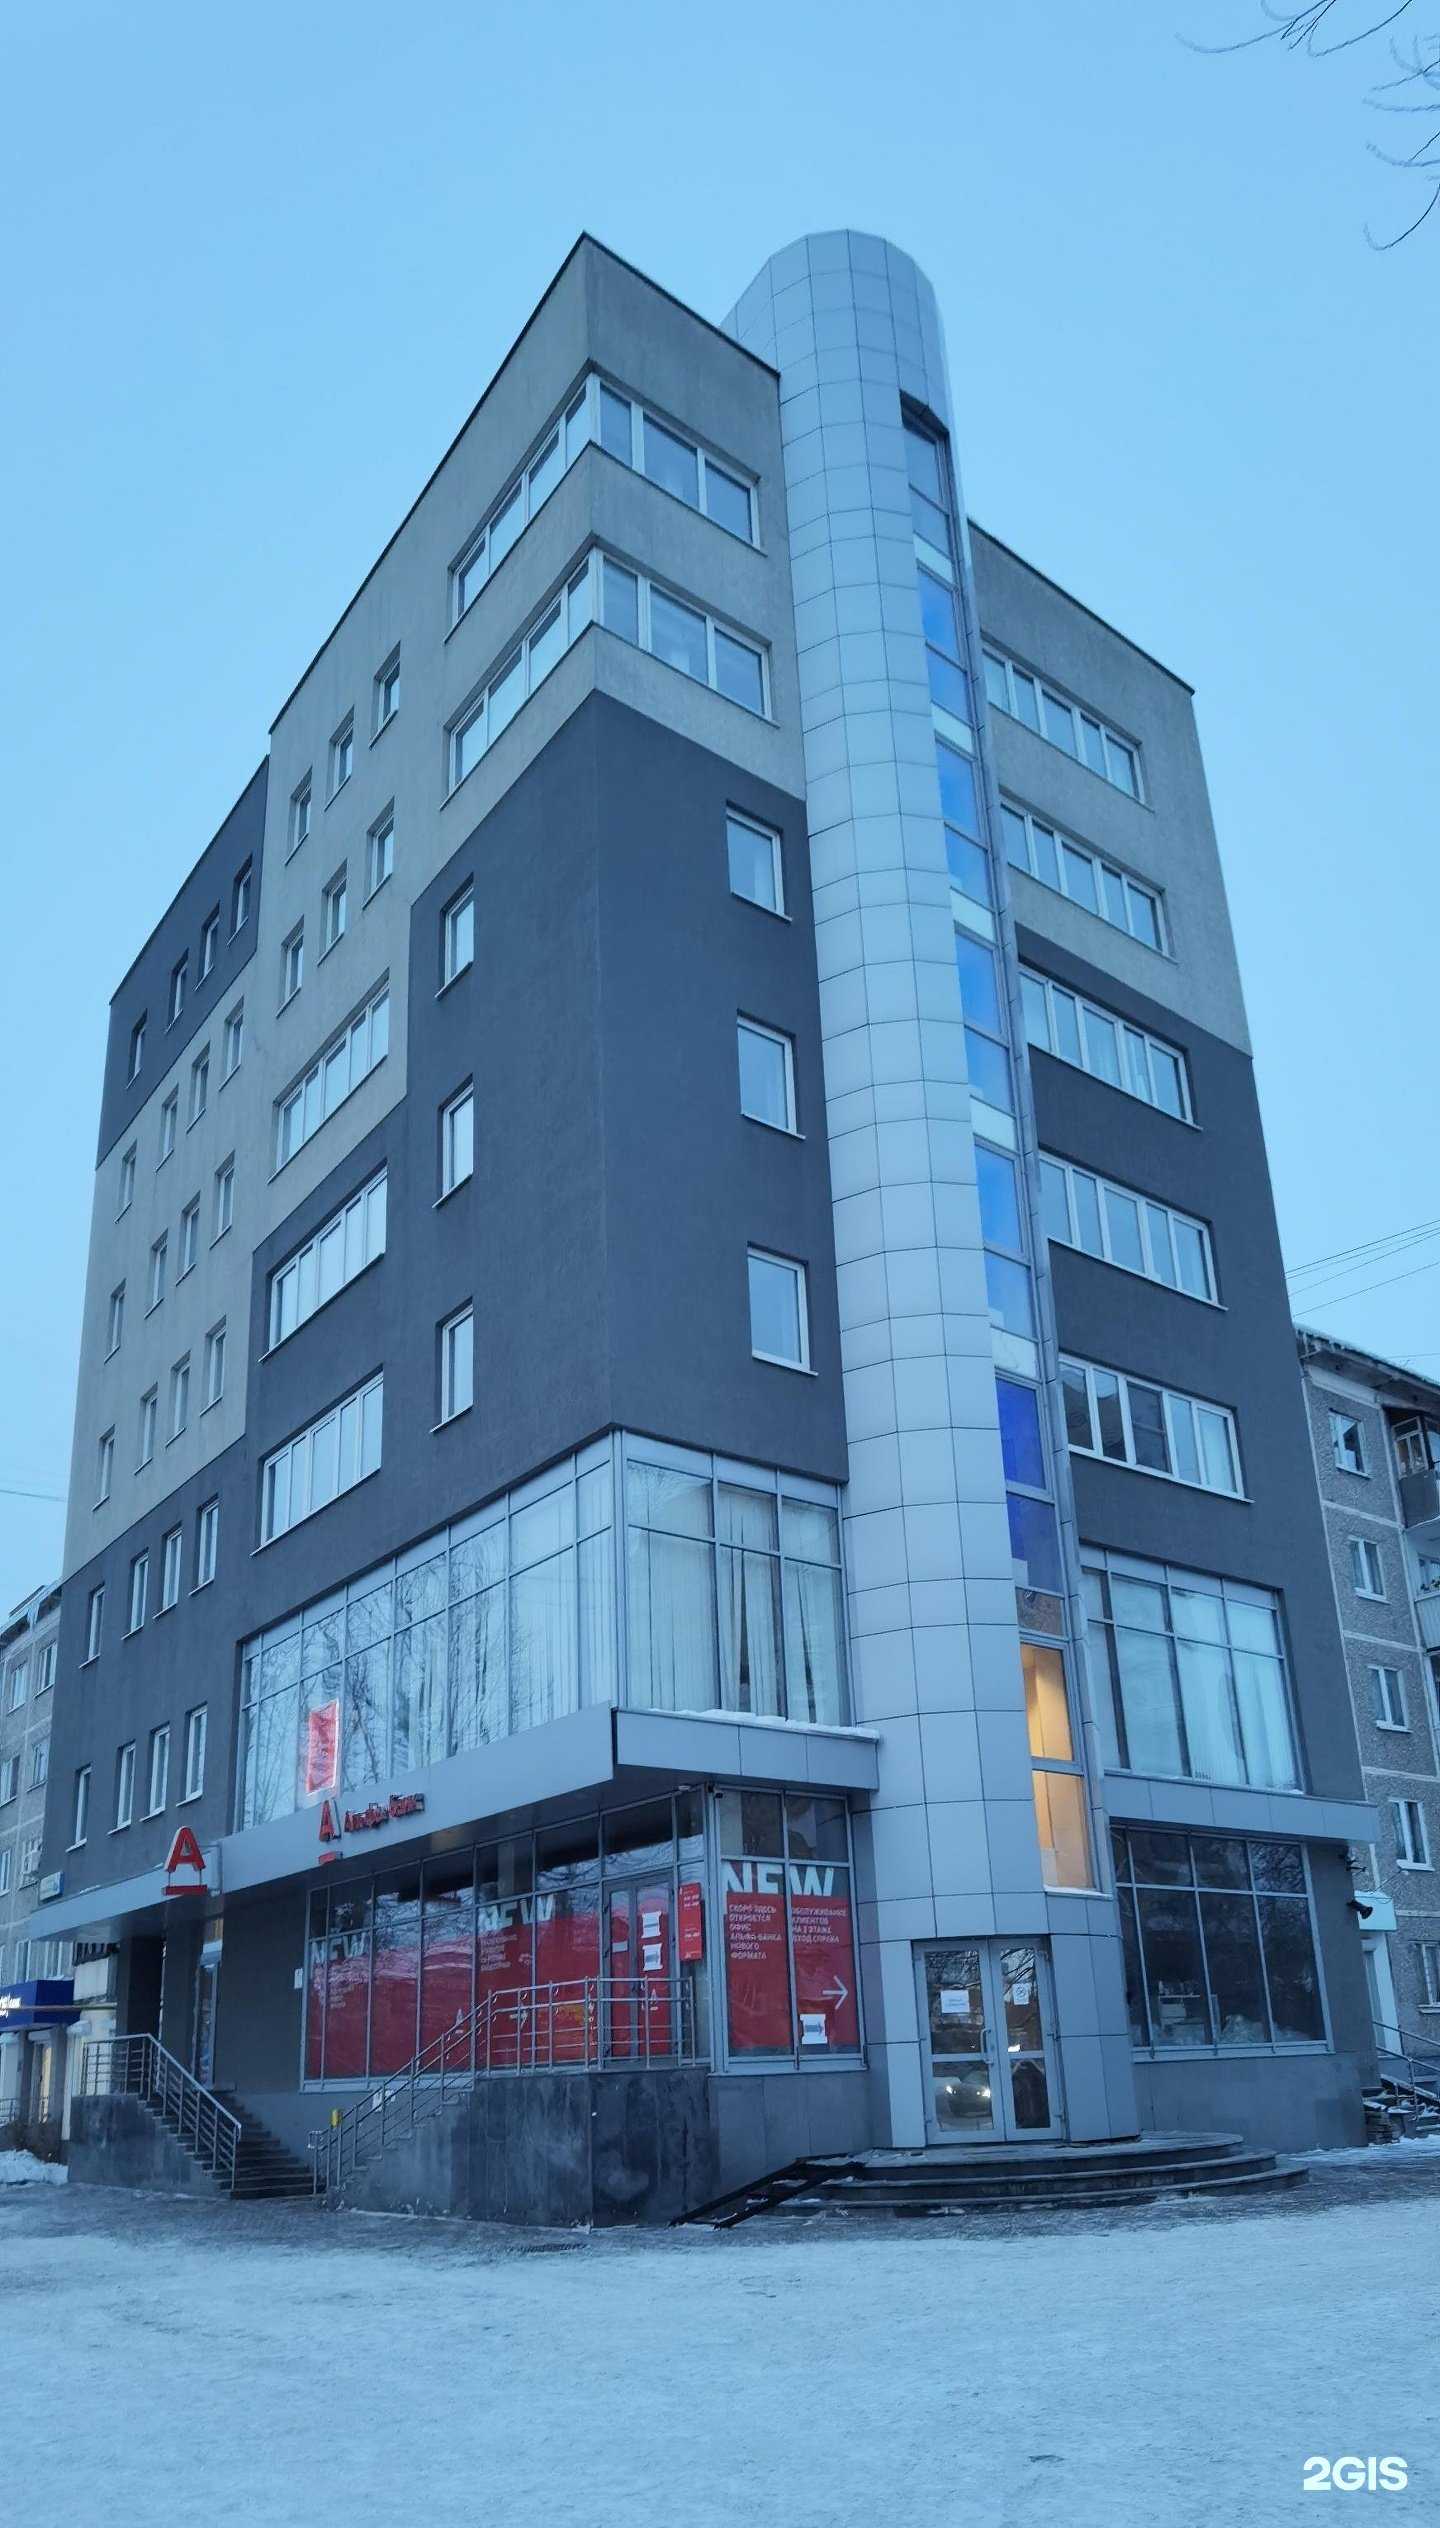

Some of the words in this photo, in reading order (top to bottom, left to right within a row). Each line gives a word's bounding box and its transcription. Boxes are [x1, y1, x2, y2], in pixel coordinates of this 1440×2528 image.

[721, 1862, 834, 1896] NEW
[478, 1893, 554, 1932] NEW
[729, 1904, 753, 1913] СКОРО
[729, 1913, 771, 1922] ОТКРОЕТСЯ
[729, 1923, 752, 1931] ОФИС
[730, 1942, 760, 1951] НОВОГО
[730, 1951, 767, 1960] ФОРМАТА
